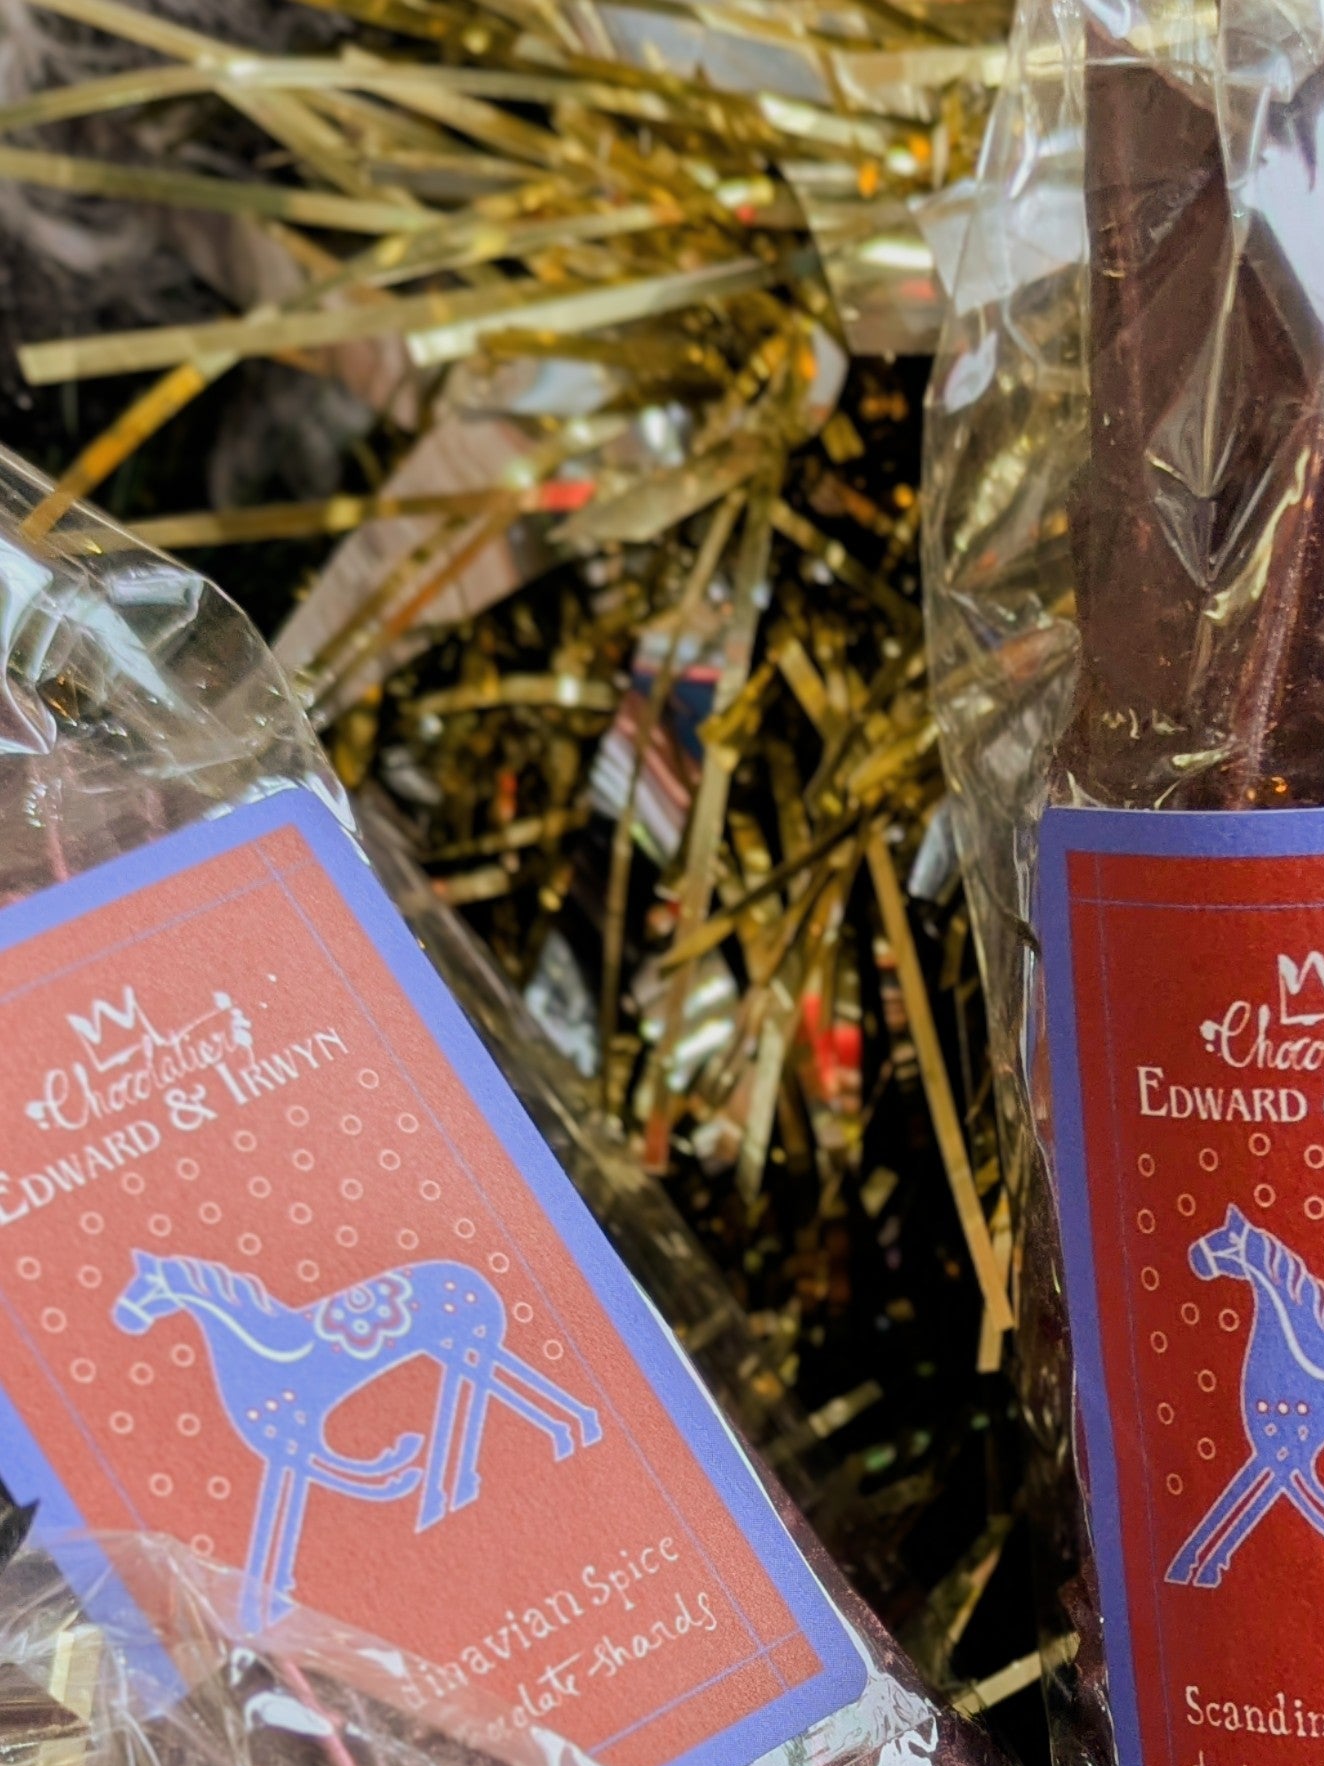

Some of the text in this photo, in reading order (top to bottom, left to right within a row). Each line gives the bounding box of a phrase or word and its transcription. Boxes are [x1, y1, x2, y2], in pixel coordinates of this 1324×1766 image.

[25, 1003, 252, 1131] Chocolatier
[165, 1085, 218, 1131] &
[214, 1027, 349, 1105] IRWYN
[1138, 1066, 1307, 1122] EDWARD
[582, 1535, 680, 1610] Spice
[588, 1592, 717, 1678] shards
